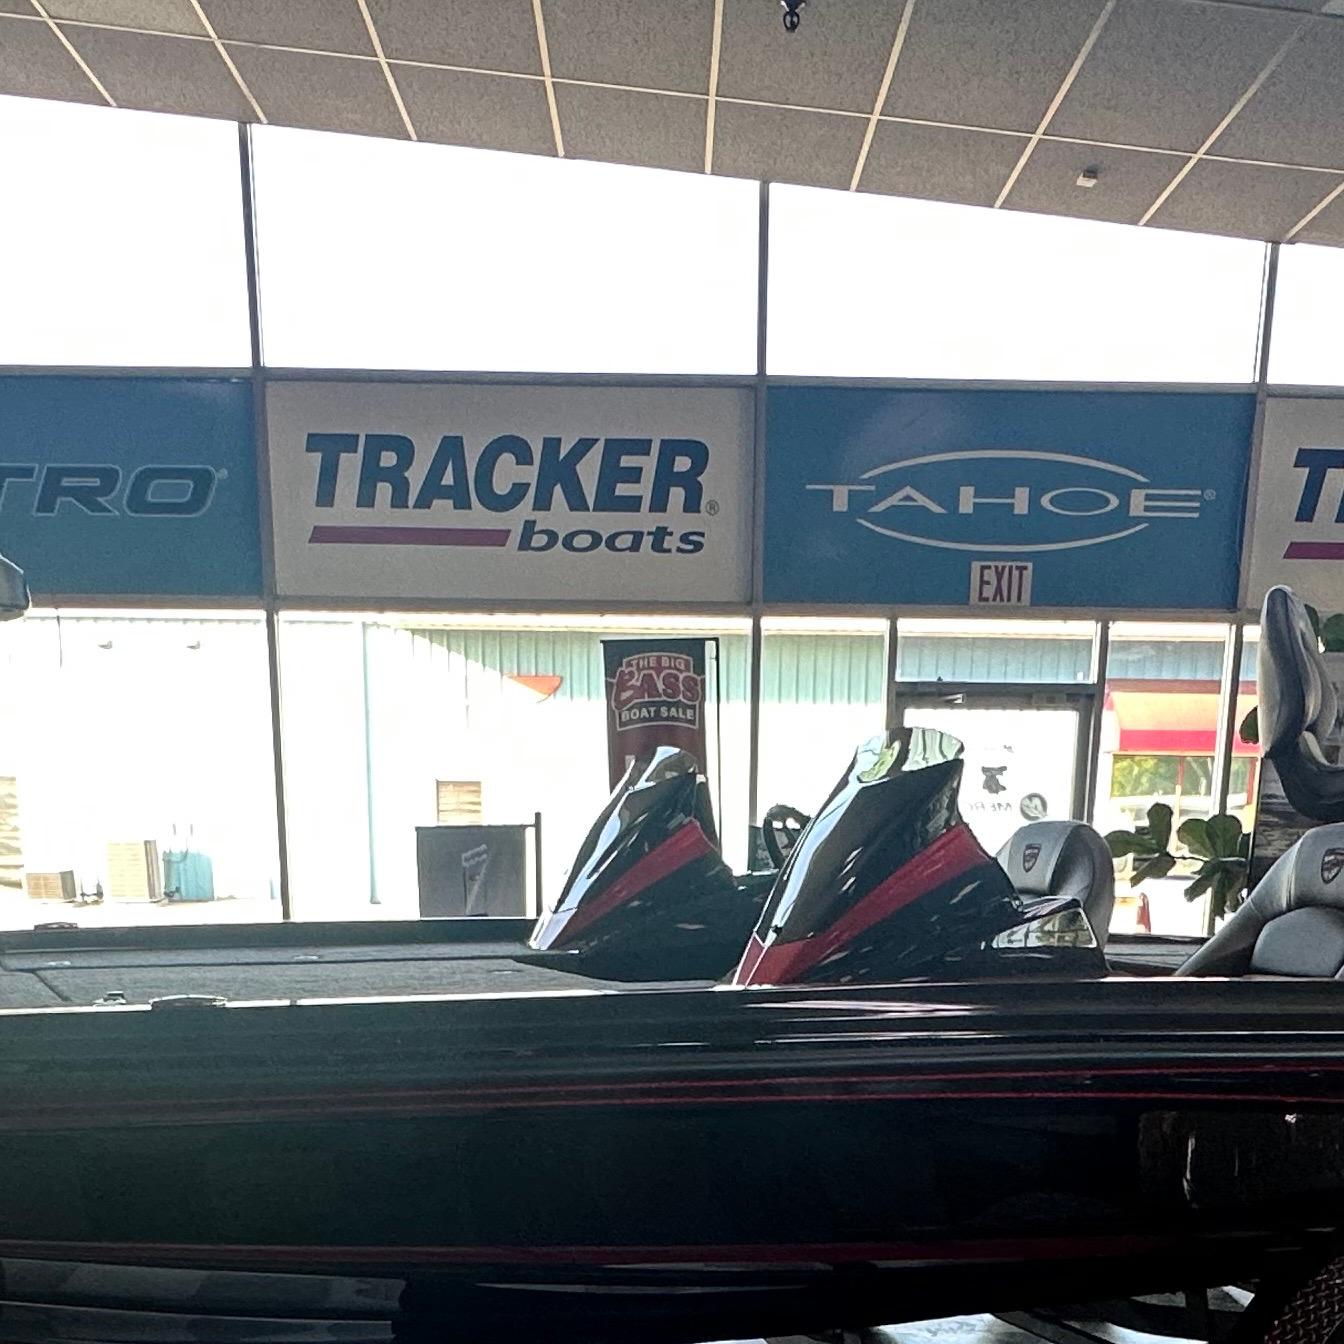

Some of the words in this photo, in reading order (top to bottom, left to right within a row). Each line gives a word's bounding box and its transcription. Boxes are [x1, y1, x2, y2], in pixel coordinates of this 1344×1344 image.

[304, 431, 710, 515] TRACKER
[805, 484, 1203, 519] TAHOE
[517, 519, 706, 554] boats
[978, 564, 1028, 602] EXIT
[630, 657, 656, 669] THE
[661, 656, 685, 671] BIG
[612, 669, 702, 711] BASS
[621, 706, 656, 722] BOAT
[660, 705, 695, 720] SALE
